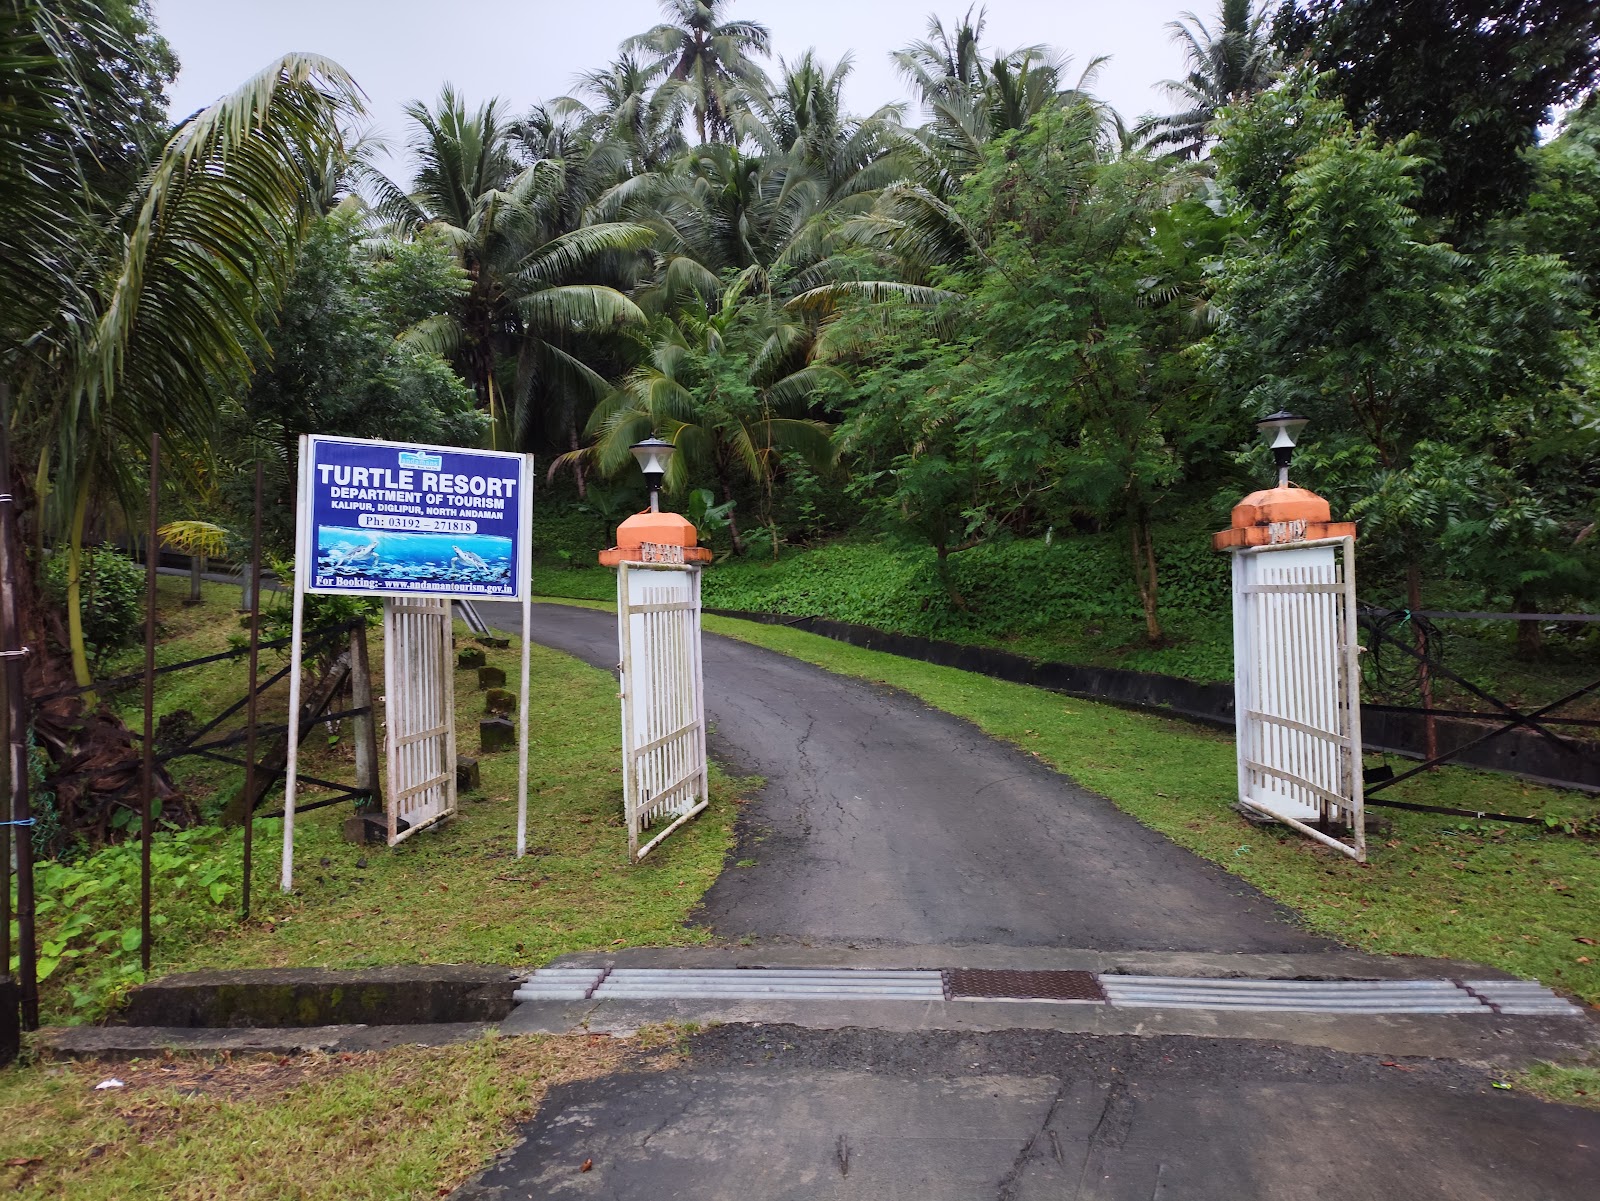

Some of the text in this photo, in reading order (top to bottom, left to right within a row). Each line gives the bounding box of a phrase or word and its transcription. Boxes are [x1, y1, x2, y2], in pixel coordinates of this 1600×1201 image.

[317, 463, 517, 498] TURTLE RESORT
[330, 486, 505, 510] DEPARTMENT OF TOURISM
[331, 500, 504, 520] KALIPUR, DIGLIPUR, NORTH ANDAMAN
[366, 516, 384, 526] Ph:
[388, 518, 420, 529] 03192
[434, 521, 471, 532] 271818
[316, 576, 334, 587] For
[384, 580, 513, 595] www.andamantourism.gov.in
